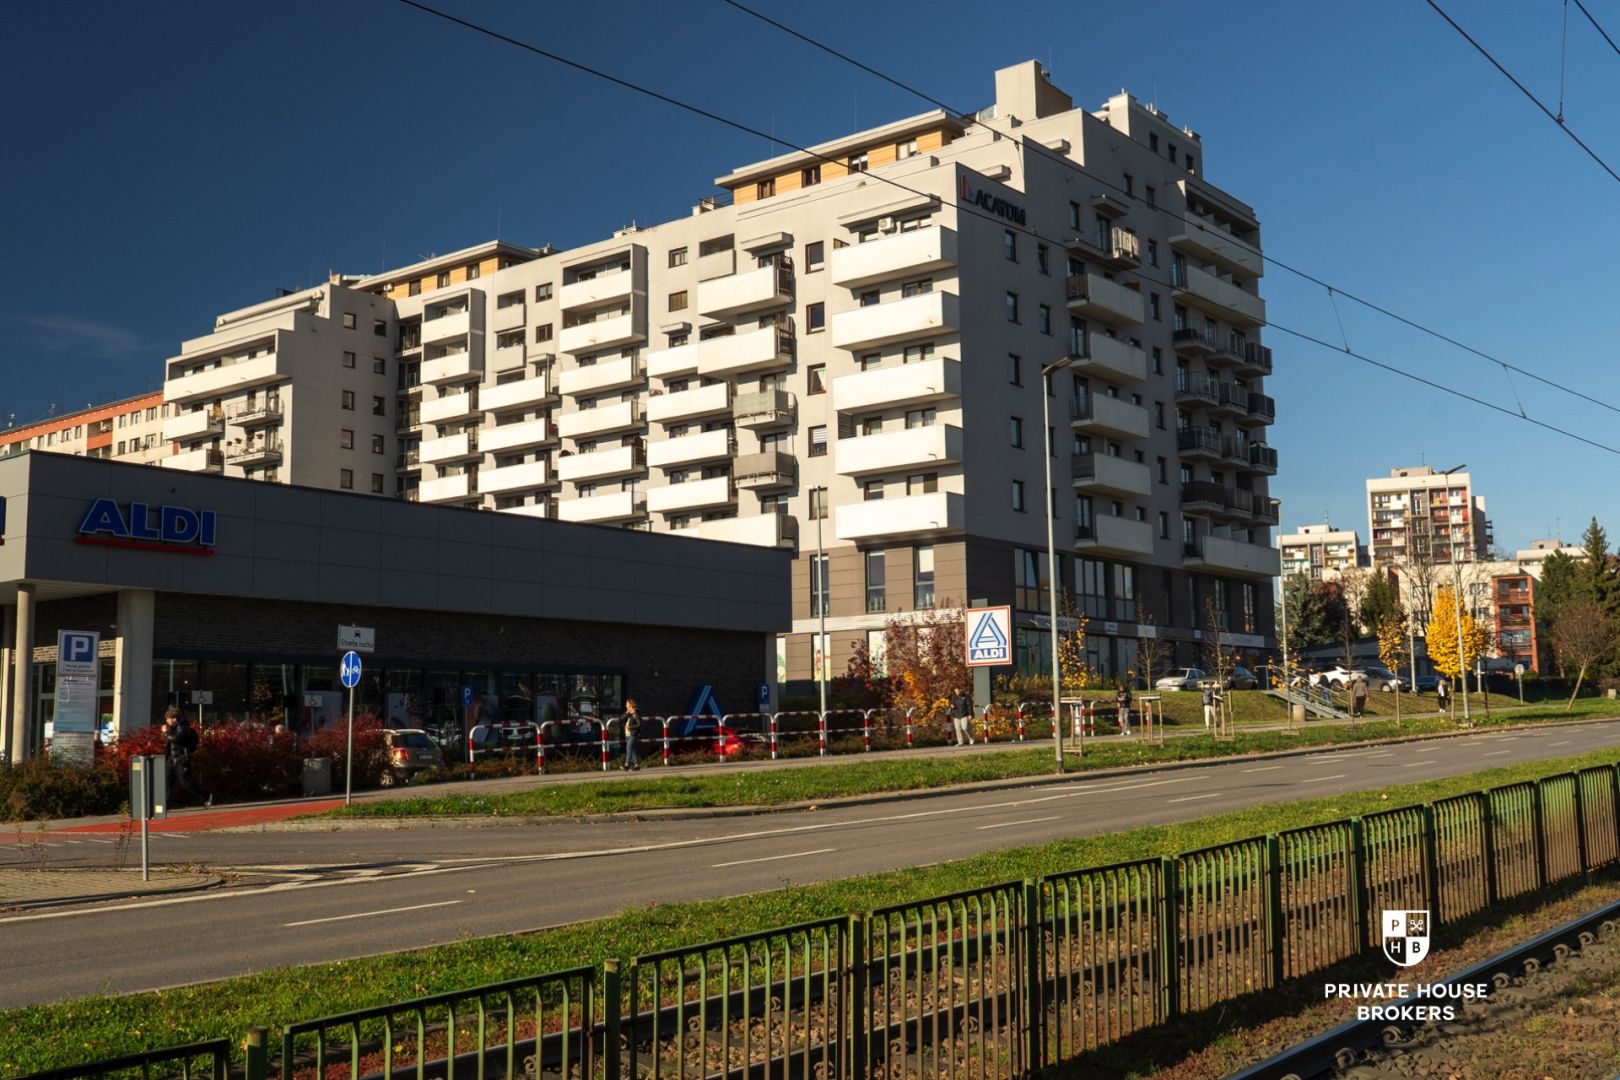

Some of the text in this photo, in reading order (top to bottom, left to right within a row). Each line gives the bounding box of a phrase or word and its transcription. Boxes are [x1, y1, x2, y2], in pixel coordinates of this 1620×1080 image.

[79, 497, 216, 546] ALDI
[70, 636, 89, 661] P
[973, 648, 1004, 660] ALDI
[464, 687, 471, 698] P
[761, 685, 768, 699] P
